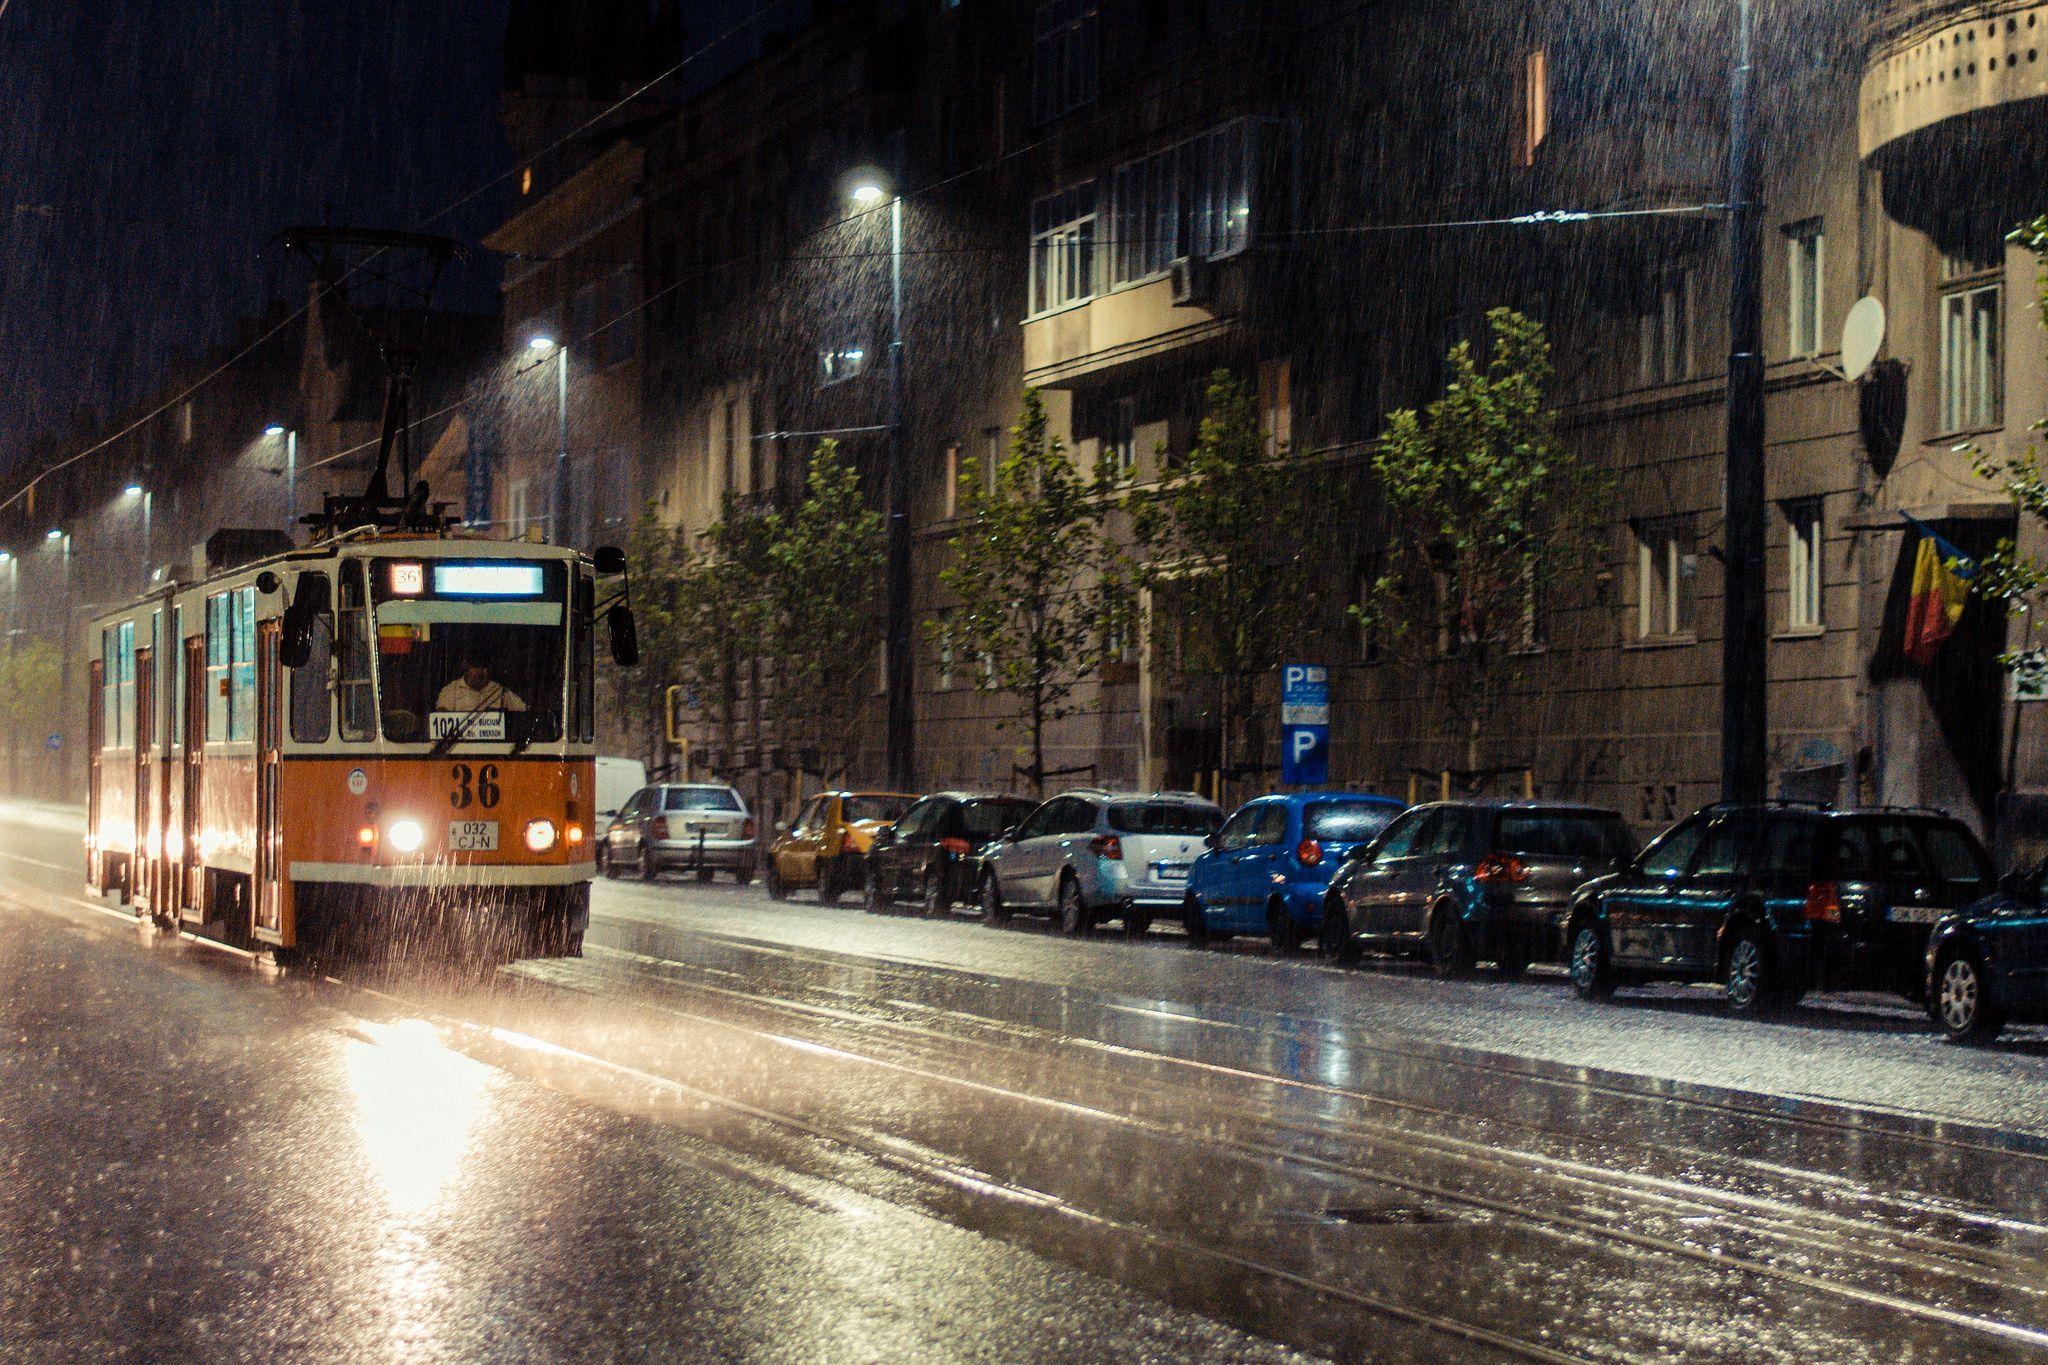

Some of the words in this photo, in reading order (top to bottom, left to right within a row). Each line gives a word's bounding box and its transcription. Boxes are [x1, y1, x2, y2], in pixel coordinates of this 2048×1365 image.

[397, 570, 417, 584] 36
[1286, 667, 1304, 692] P
[1294, 731, 1316, 763] P
[450, 764, 500, 809] 36
[463, 822, 487, 835] 032
[458, 836, 490, 849] CJ-N
